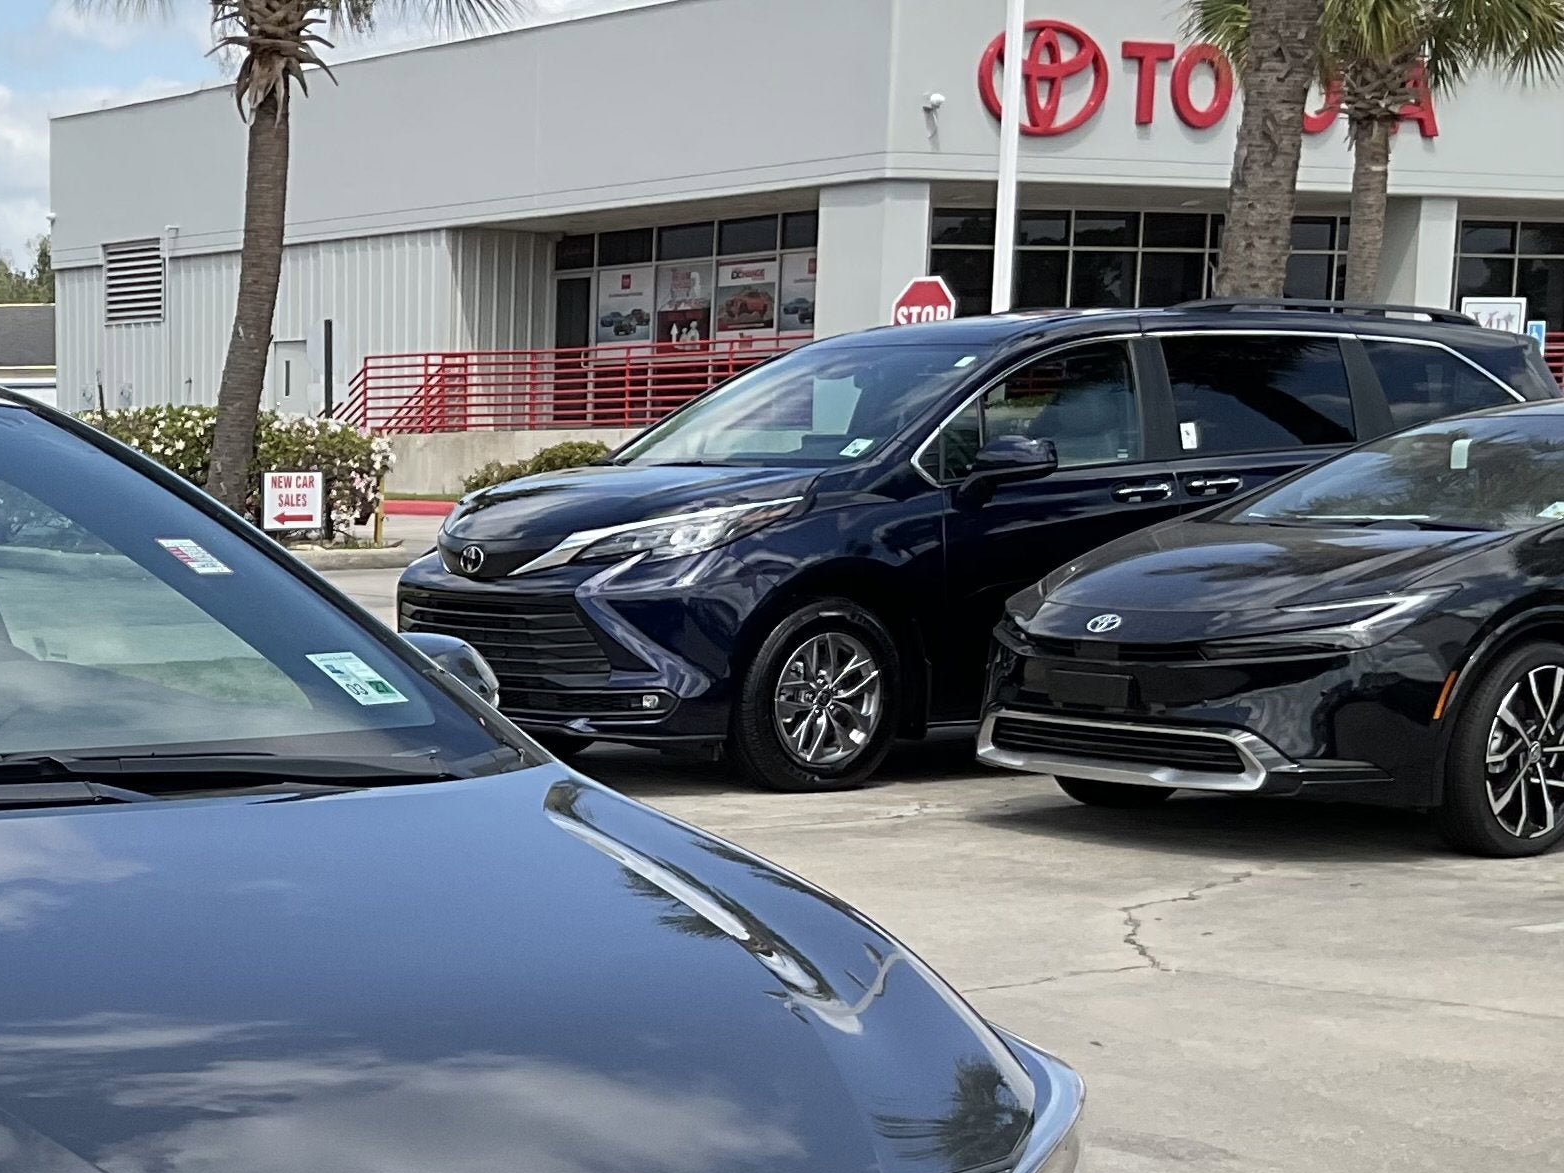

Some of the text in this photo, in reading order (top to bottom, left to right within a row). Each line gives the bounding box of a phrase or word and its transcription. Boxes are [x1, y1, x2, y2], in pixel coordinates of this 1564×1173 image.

[1122, 41, 1439, 137] TOA
[897, 305, 949, 325] STOP
[271, 475, 315, 489] NEW CAR
[278, 493, 307, 507] SALES
